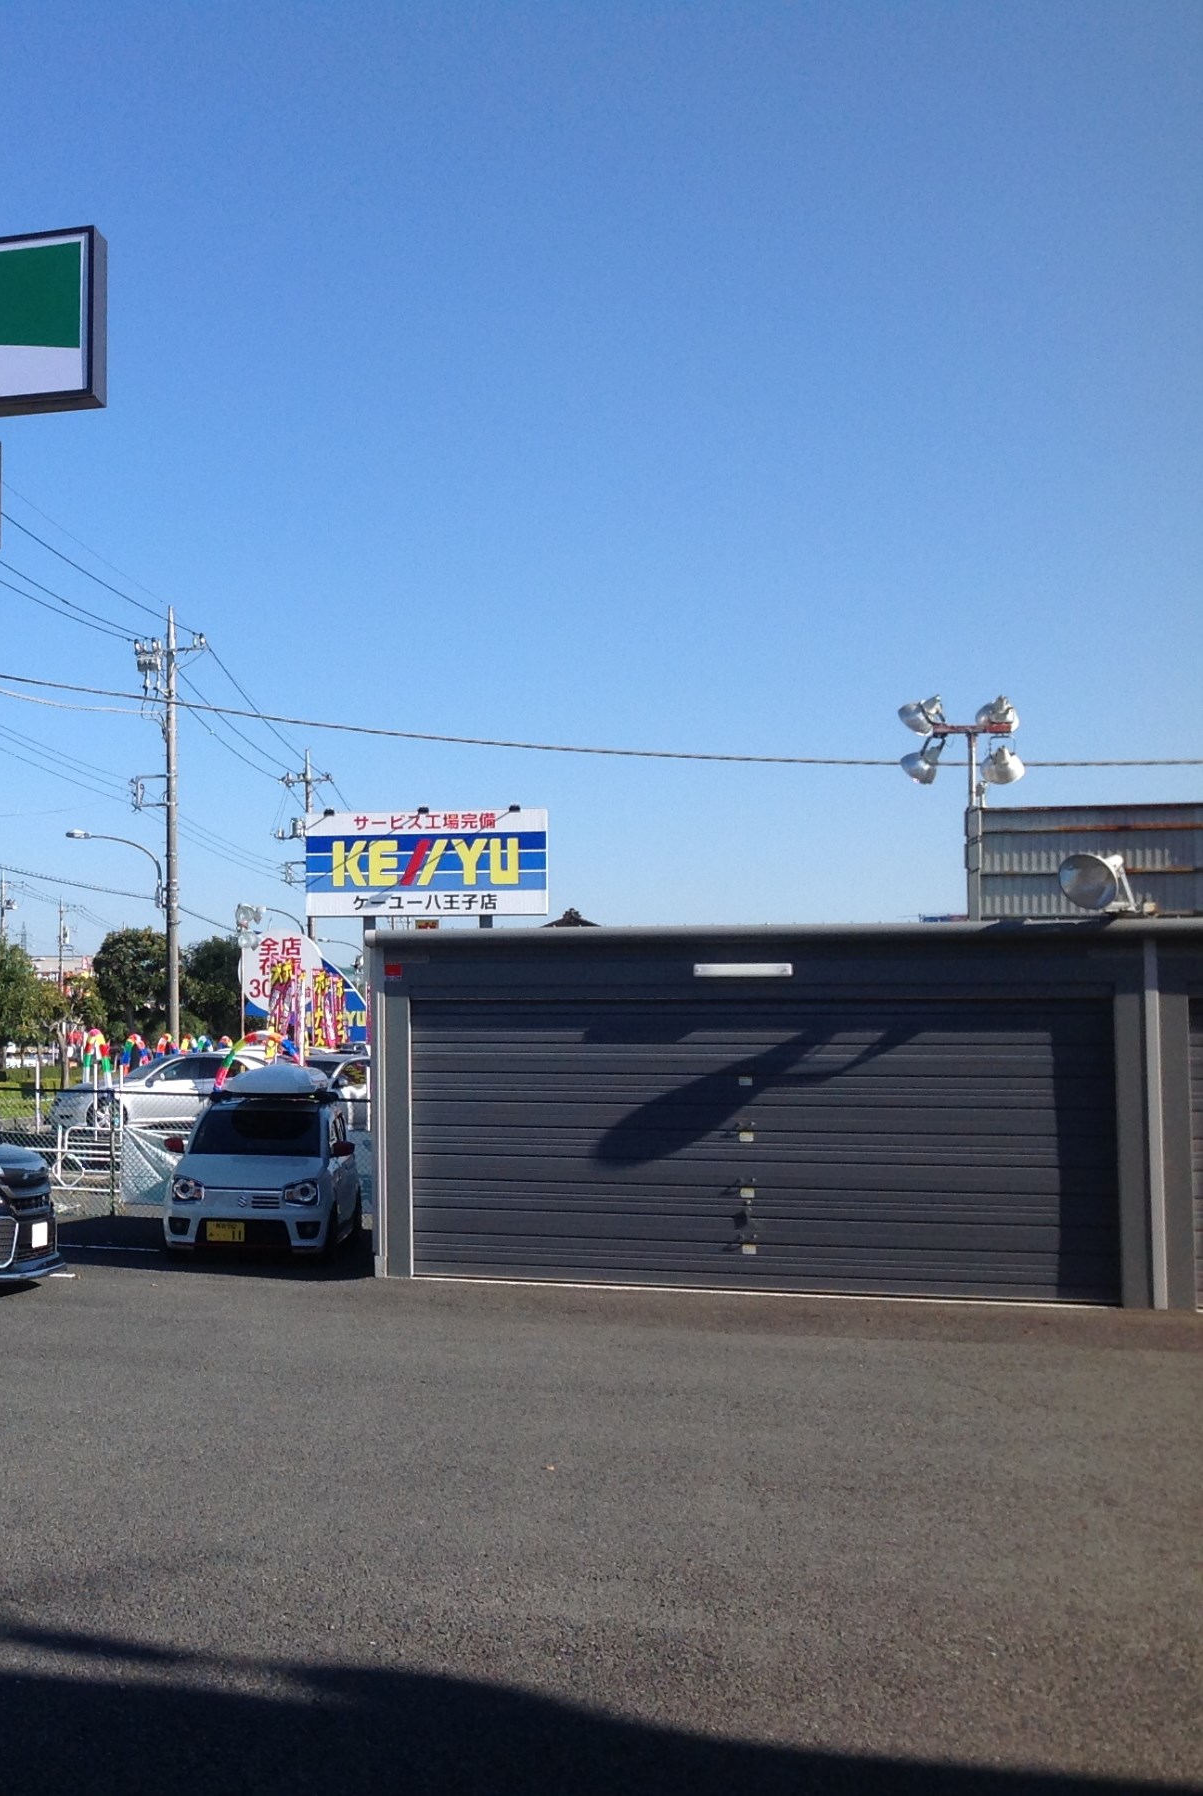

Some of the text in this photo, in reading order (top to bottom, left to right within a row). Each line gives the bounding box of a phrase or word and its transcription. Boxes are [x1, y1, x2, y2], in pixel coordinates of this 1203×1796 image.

[353, 812, 496, 831] サービス工場完備
[352, 893, 498, 911] ケーユー八王子店
[259, 937, 301, 956] 全店
